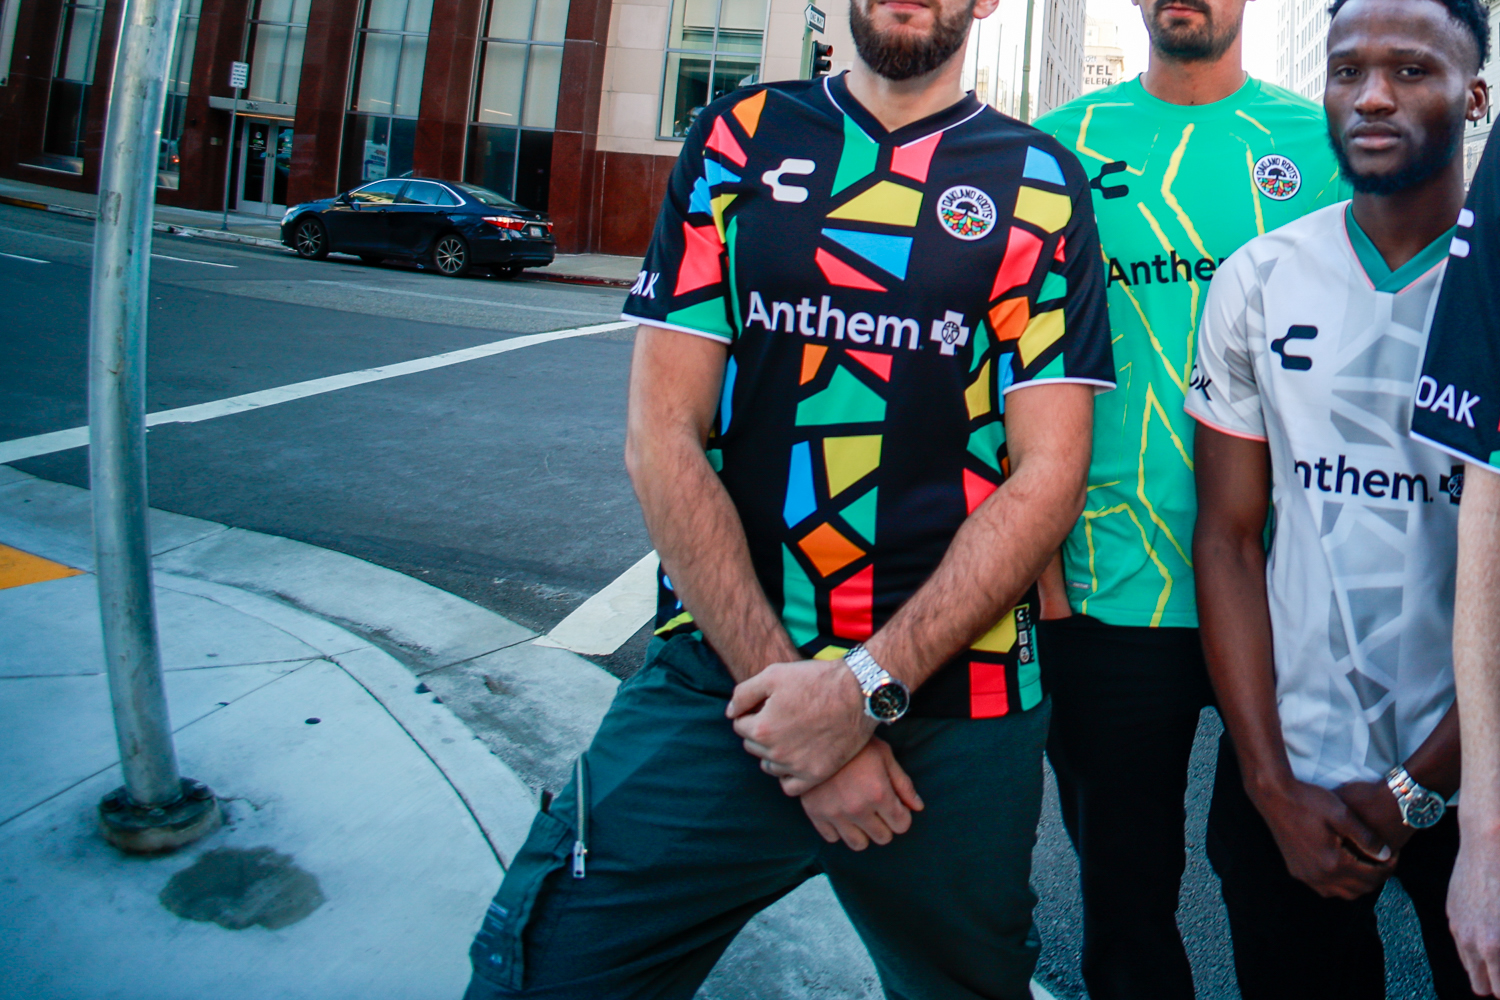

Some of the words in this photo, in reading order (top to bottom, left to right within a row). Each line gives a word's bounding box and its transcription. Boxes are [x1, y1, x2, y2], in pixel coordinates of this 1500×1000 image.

[816, 15, 825, 26] WAY
[1084, 64, 1113, 76] TEL
[1084, 77, 1112, 85] ELERS
[1257, 157, 1281, 176] OAKLAND
[1281, 159, 1298, 180] ROOTS
[942, 188, 977, 208] OAKLAND
[976, 193, 993, 220] ROOTS
[1106, 250, 1228, 288] Anthe
[630, 270, 660, 300] AK
[1415, 374, 1481, 428] OAK
